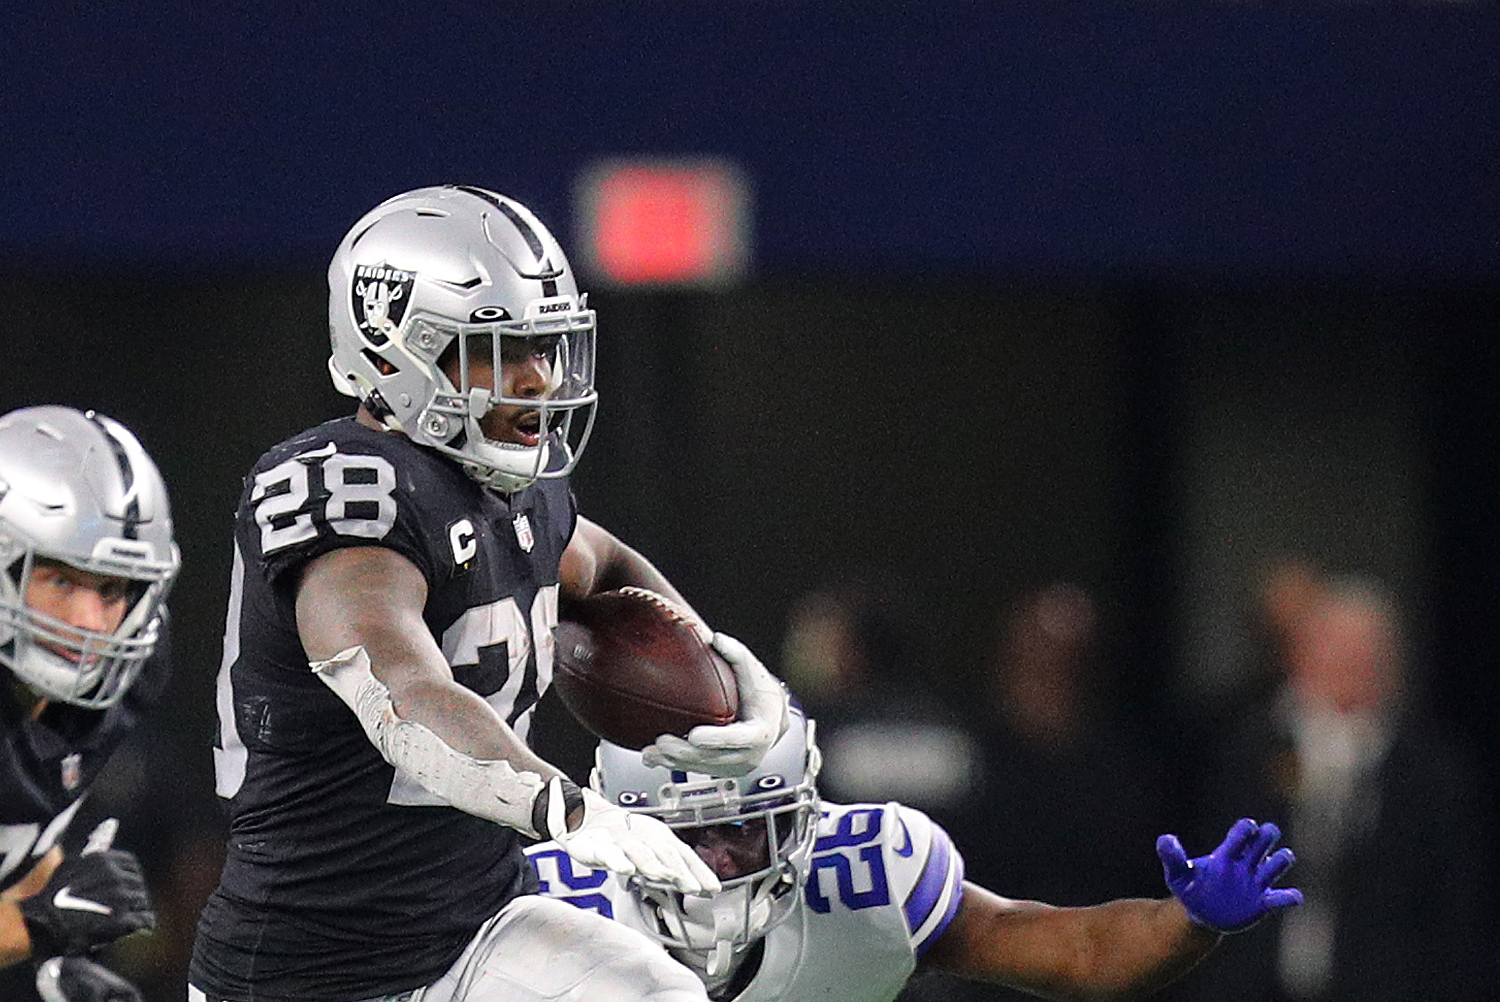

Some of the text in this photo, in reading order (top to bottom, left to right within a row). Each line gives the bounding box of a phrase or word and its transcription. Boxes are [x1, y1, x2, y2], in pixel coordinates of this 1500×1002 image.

[357, 266, 409, 283] RAIDERS
[251, 454, 397, 554] 28
[449, 519, 477, 565] C
[804, 808, 891, 915] 26
